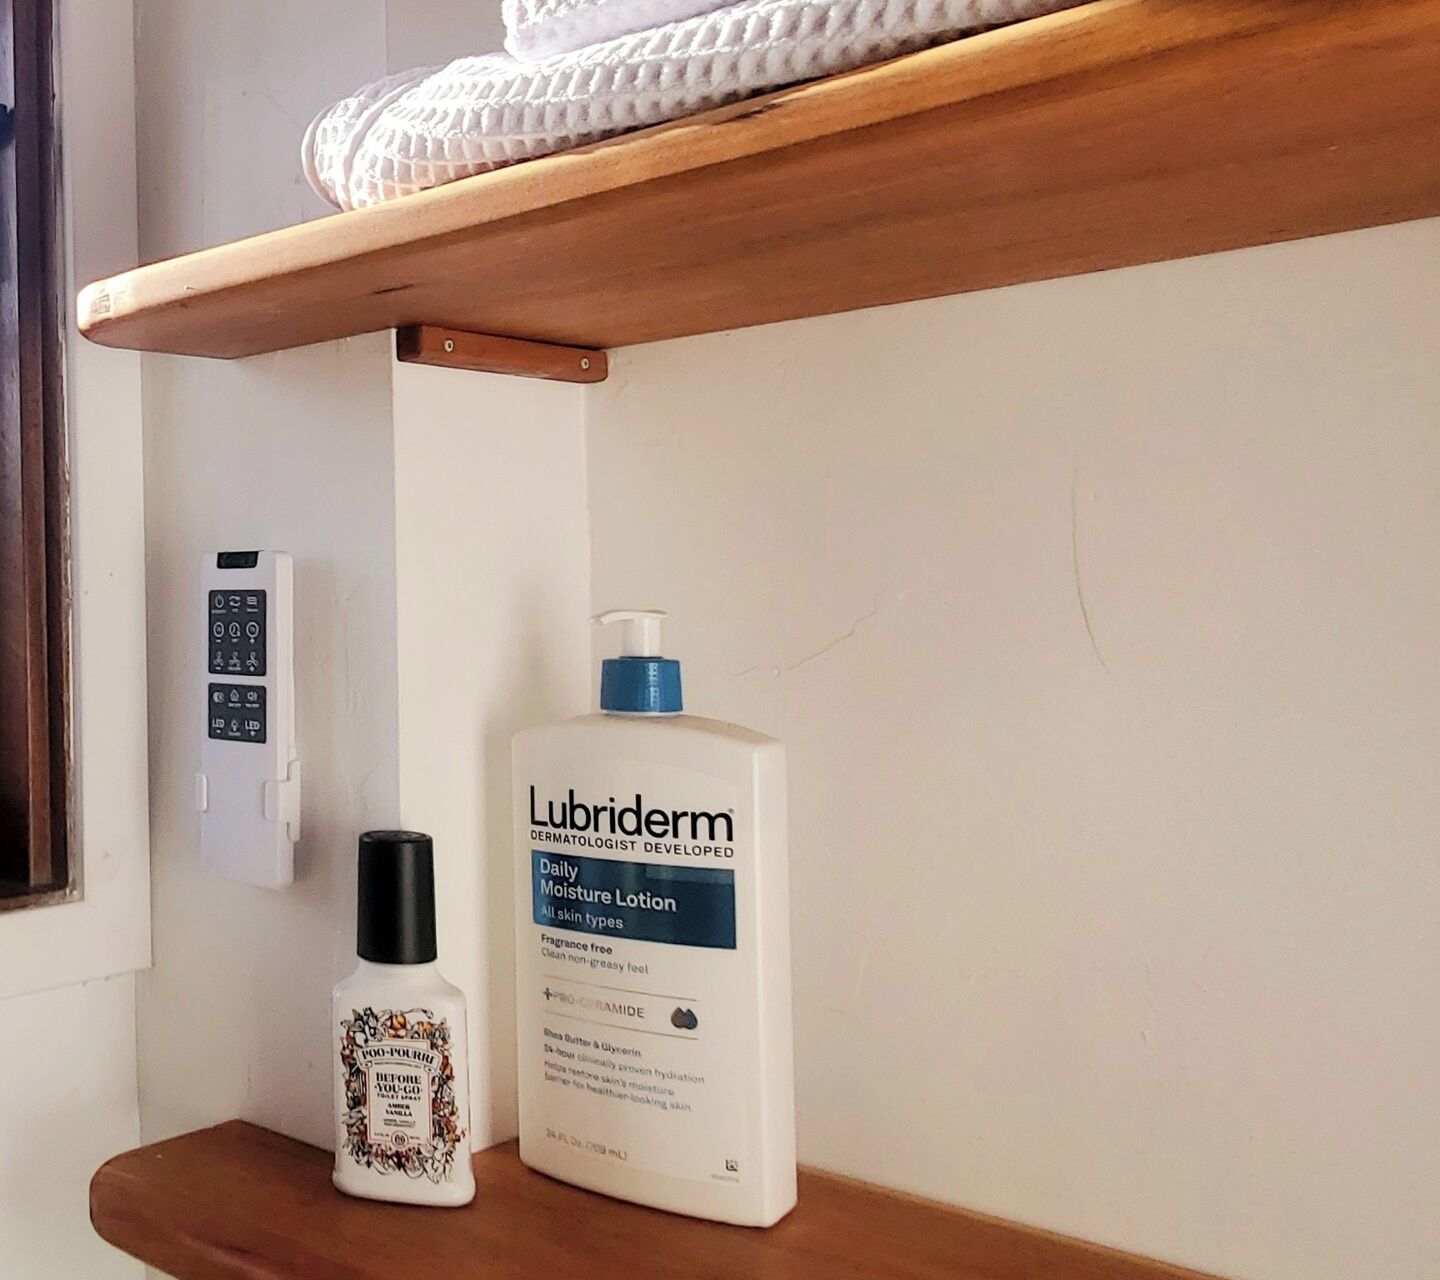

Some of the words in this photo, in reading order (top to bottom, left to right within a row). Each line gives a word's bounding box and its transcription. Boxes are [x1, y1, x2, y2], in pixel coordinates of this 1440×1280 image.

[530, 785, 733, 842] Lubriderm
[531, 830, 637, 852] DERMATOLOGIST
[644, 842, 734, 858] DEVELOPED
[540, 859, 578, 880] Daily
[540, 879, 612, 905] Moisture
[616, 889, 677, 912] Lotion
[541, 905, 555, 919] All
[557, 908, 582, 923] skin
[585, 913, 624, 929] types
[541, 933, 589, 952] Fragrance
[590, 943, 613, 955] free
[541, 947, 566, 961] Clean
[568, 953, 624, 974] non-greasy
[627, 962, 649, 974] feel
[564, 1034, 591, 1047] Butter
[376, 1072, 422, 1085] BEFORE
[654, 1068, 705, 1084] hydration
